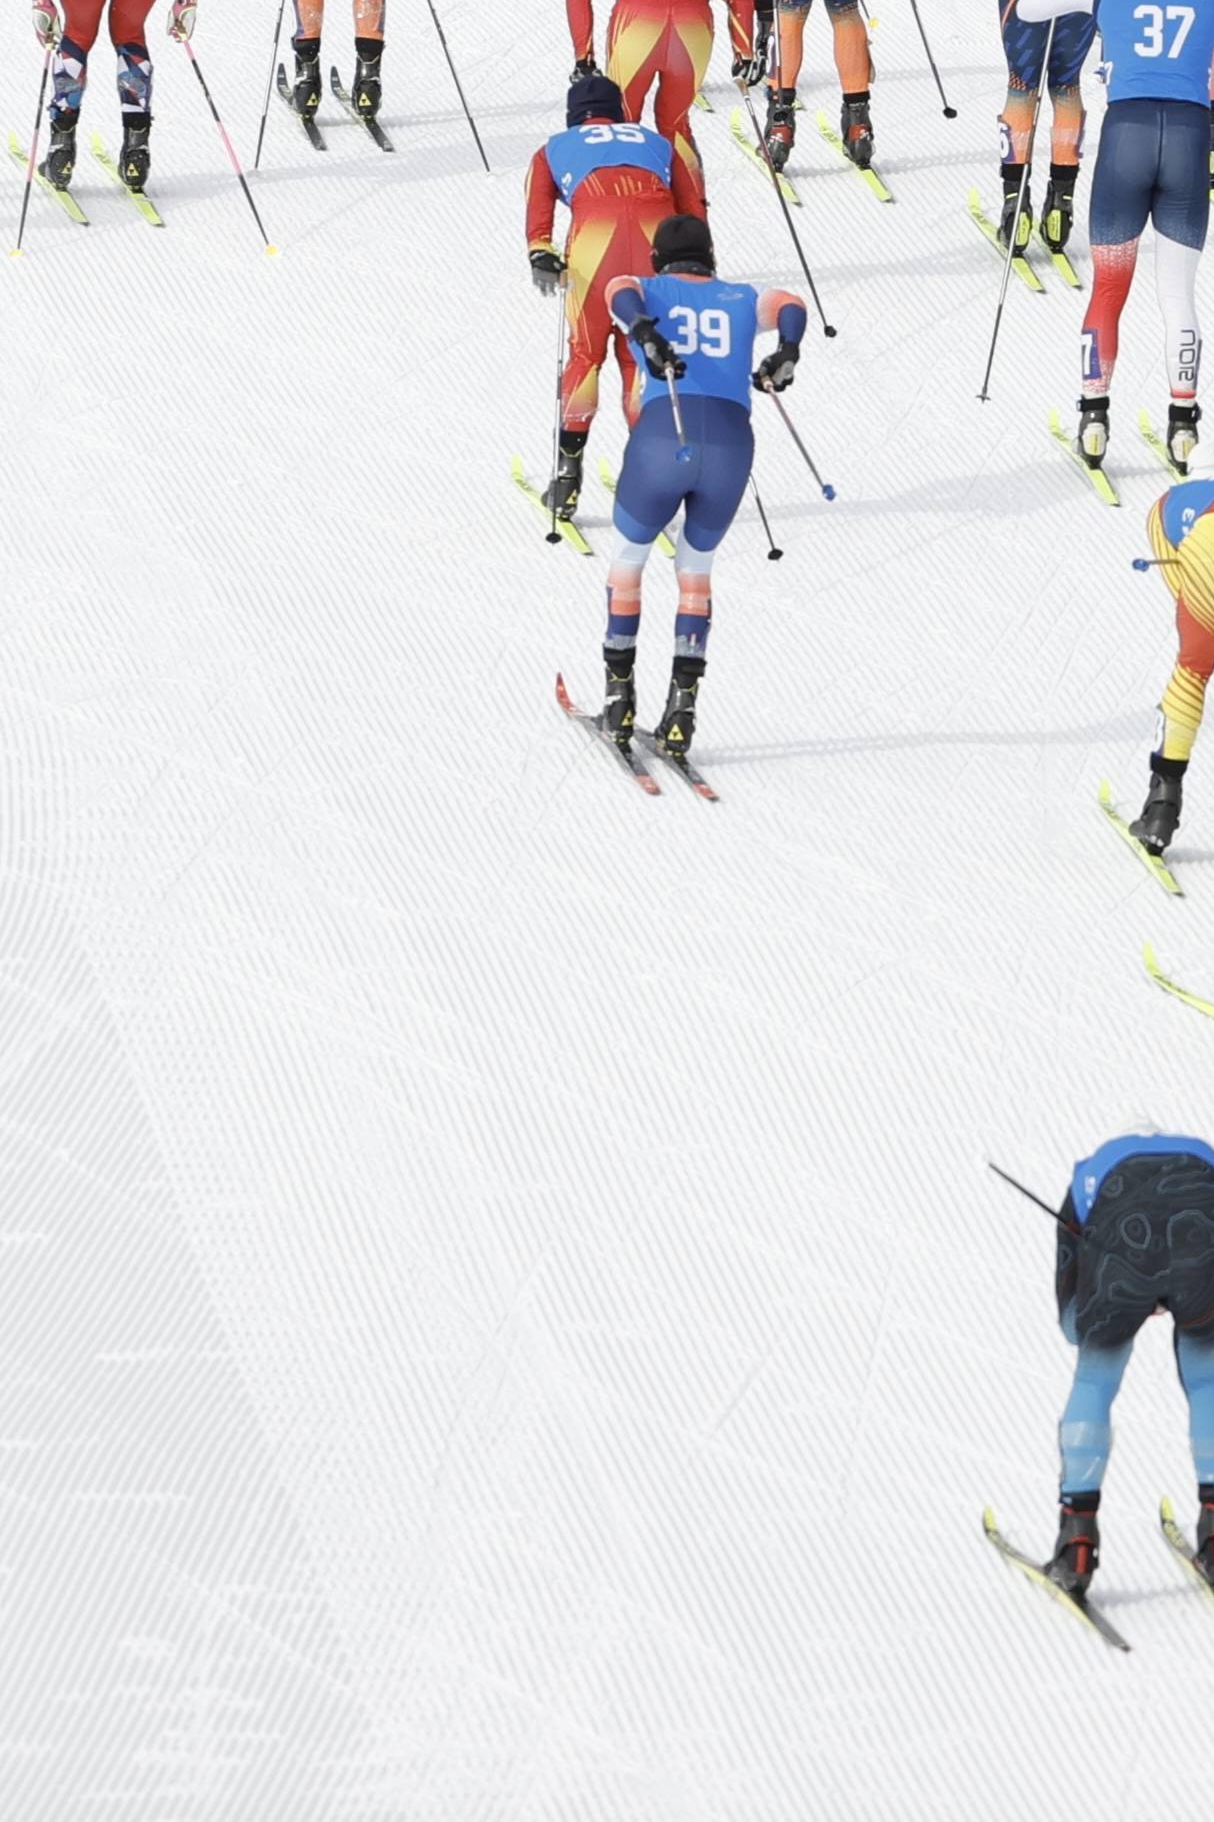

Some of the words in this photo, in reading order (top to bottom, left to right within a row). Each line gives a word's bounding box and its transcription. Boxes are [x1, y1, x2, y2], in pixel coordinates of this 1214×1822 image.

[1134, 5, 1195, 58] 37
[579, 124, 645, 144] 35
[669, 306, 730, 357] 39
